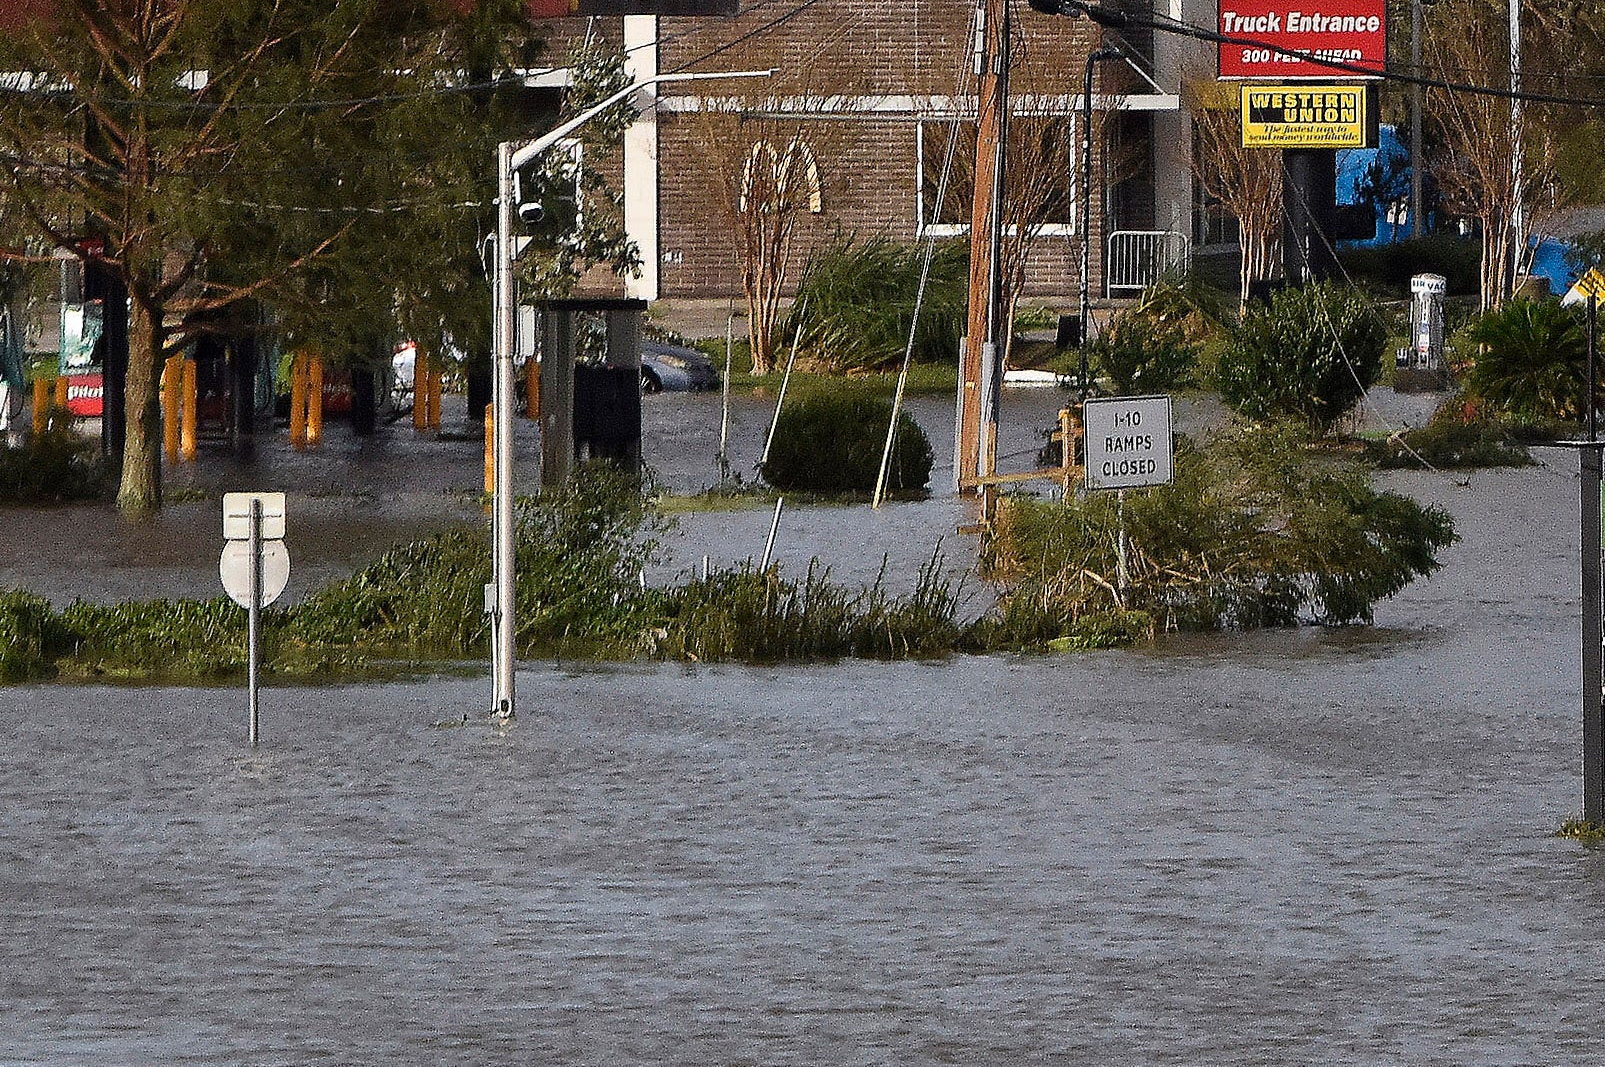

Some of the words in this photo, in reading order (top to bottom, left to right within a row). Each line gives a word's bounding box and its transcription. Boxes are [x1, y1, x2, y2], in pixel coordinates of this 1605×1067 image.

[1222, 11, 1281, 33] Truck
[1286, 11, 1380, 33] Entrance
[1241, 49, 1271, 63] 300
[1251, 93, 1356, 109] WESTERN
[1283, 107, 1356, 123] UNION
[1113, 411, 1142, 428] I-10
[1105, 435, 1153, 453] RAMPS
[1102, 459, 1157, 476] CLOSED
